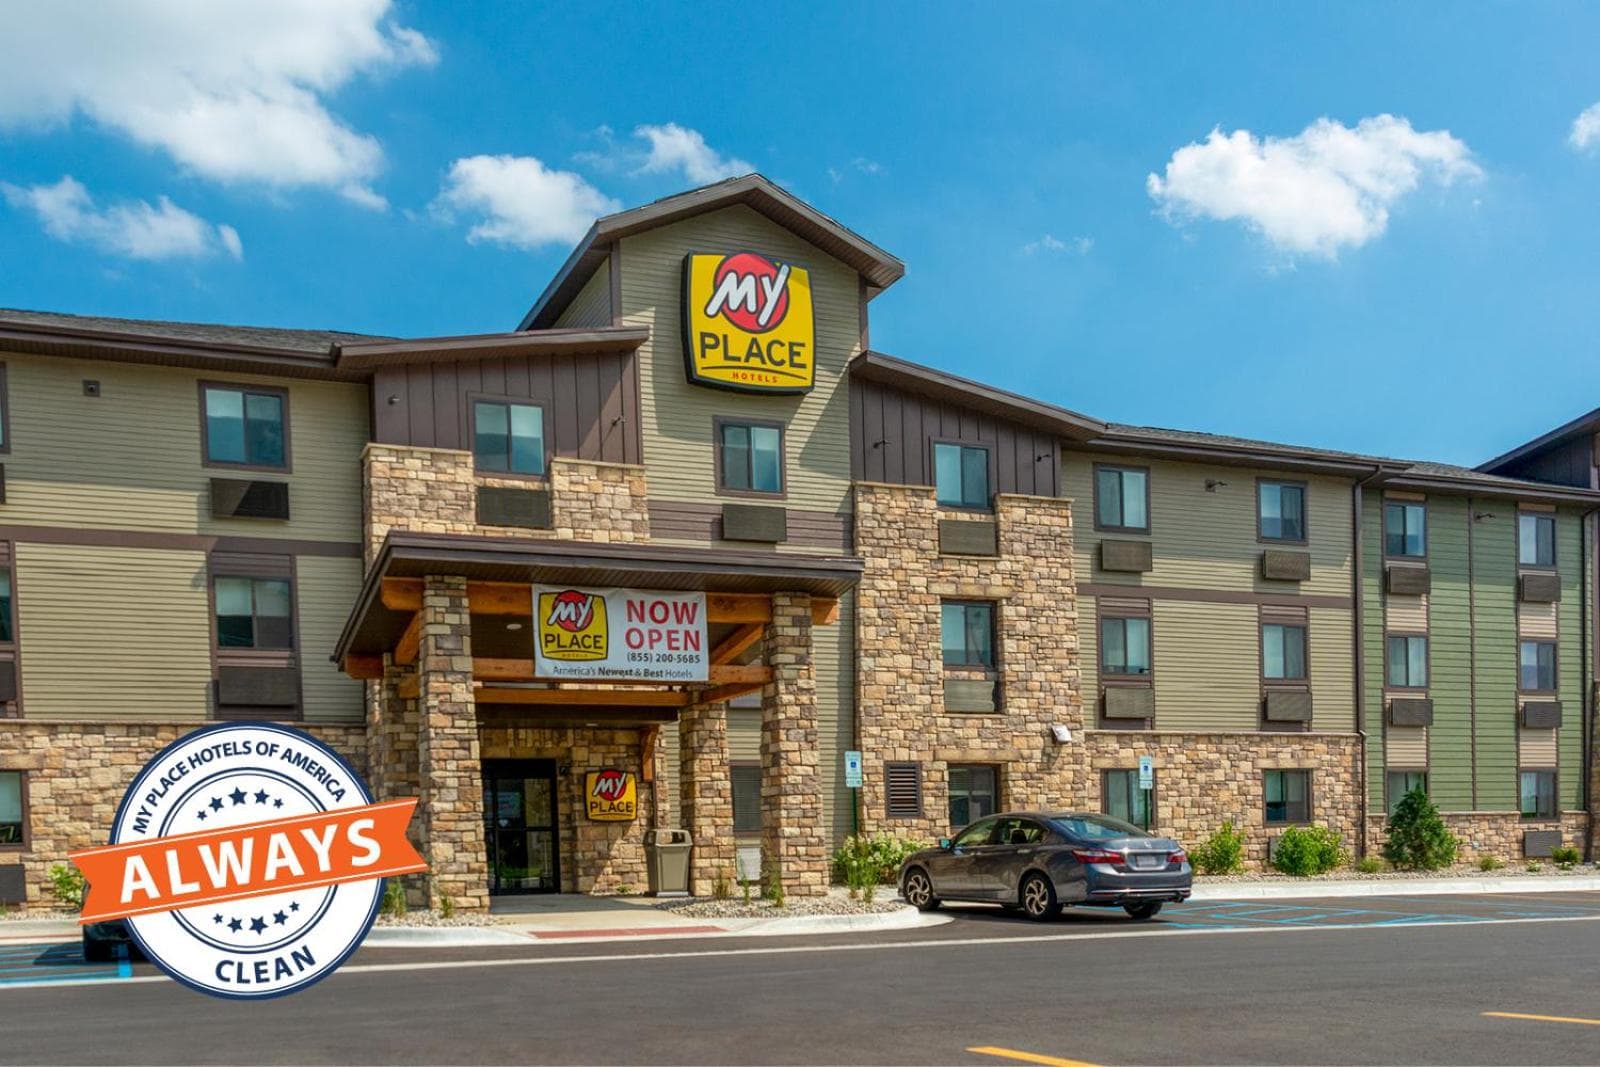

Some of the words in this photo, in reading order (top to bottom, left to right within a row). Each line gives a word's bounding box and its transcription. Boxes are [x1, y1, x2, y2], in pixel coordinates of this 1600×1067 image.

[699, 331, 808, 369] PLACE
[732, 372, 778, 384] HOTELS
[626, 600, 699, 625] NOW
[544, 633, 604, 650] PLACE
[625, 627, 700, 652] OPEN
[627, 652, 653, 663] (855)
[655, 653, 701, 664] 200-5685
[553, 666, 596, 676] America's
[598, 667, 633, 677] Newest
[634, 668, 642, 677] &
[643, 668, 663, 678] Best
[665, 669, 693, 679] Hotels
[590, 801, 634, 813] PLACE
